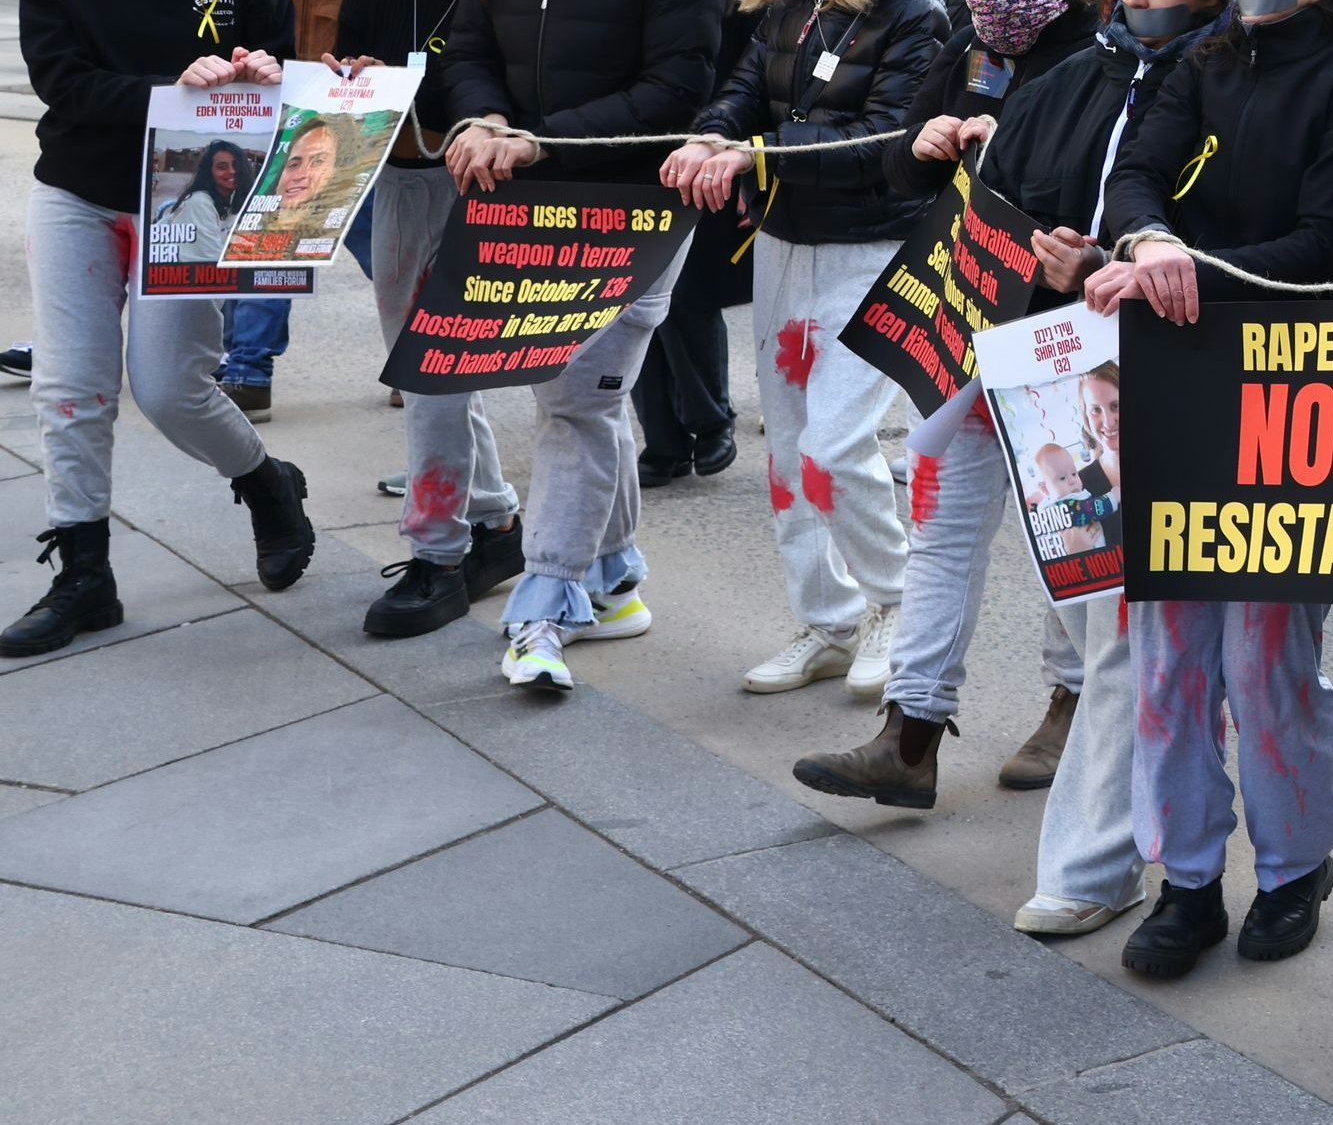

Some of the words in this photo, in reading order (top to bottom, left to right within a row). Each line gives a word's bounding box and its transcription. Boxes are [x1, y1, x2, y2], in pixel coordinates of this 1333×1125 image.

[196, 105, 217, 118] EDEN
[219, 105, 273, 117] YERUSHALMI
[225, 118, 243, 130] (24)
[247, 195, 282, 212] BRING
[466, 199, 529, 227] Hamas
[533, 204, 577, 230] uses
[581, 207, 627, 234] rape
[631, 208, 655, 231] as
[658, 209, 673, 232] a
[150, 223, 197, 244] BRING
[238, 213, 263, 231] HER
[149, 243, 180, 264] HER
[478, 241, 554, 269] weapon
[557, 245, 578, 267] of
[580, 243, 634, 268] terror.
[147, 265, 193, 285] HOME
[194, 265, 238, 284] NOW!
[253, 276, 283, 286] FAMILIES
[284, 276, 307, 286] FORUM
[980, 270, 999, 307] ein.
[464, 276, 515, 303] Since
[517, 277, 583, 304] October
[581, 278, 602, 303] 7,
[599, 276, 633, 300] 136
[410, 309, 503, 341] hostages
[500, 314, 517, 339] in
[518, 315, 557, 336] Gaza
[558, 311, 584, 332] are
[587, 306, 619, 330] still
[863, 302, 907, 343] den
[887, 264, 940, 319] immer
[962, 342, 976, 376] in
[419, 347, 456, 374] the
[454, 350, 506, 375] hands
[505, 347, 525, 369] of
[1034, 343, 1056, 362] SHIRI
[1056, 336, 1082, 356] BIBAS
[1053, 356, 1071, 375] (32)
[1028, 503, 1073, 536] BRING
[1035, 533, 1067, 562] HER
[1045, 557, 1088, 588] HOME
[1085, 544, 1124, 579] NOW!
